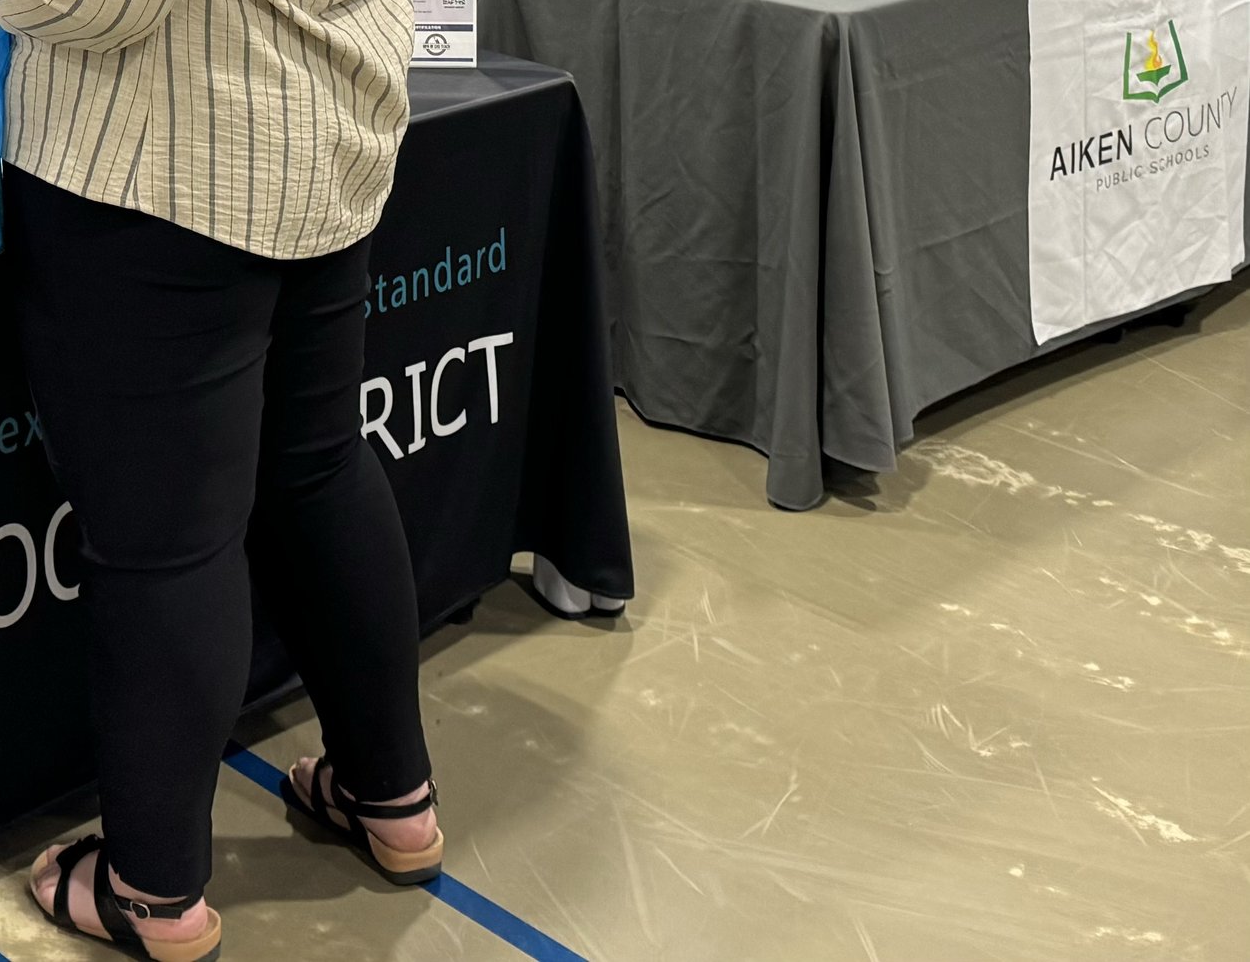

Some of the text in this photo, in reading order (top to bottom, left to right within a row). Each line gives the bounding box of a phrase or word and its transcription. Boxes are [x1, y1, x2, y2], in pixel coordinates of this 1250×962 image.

[1049, 86, 1238, 181] AIKEN COUNTY
[1095, 144, 1211, 192] PUBLIC SCHOOLS
[359, 331, 514, 461] RICT
